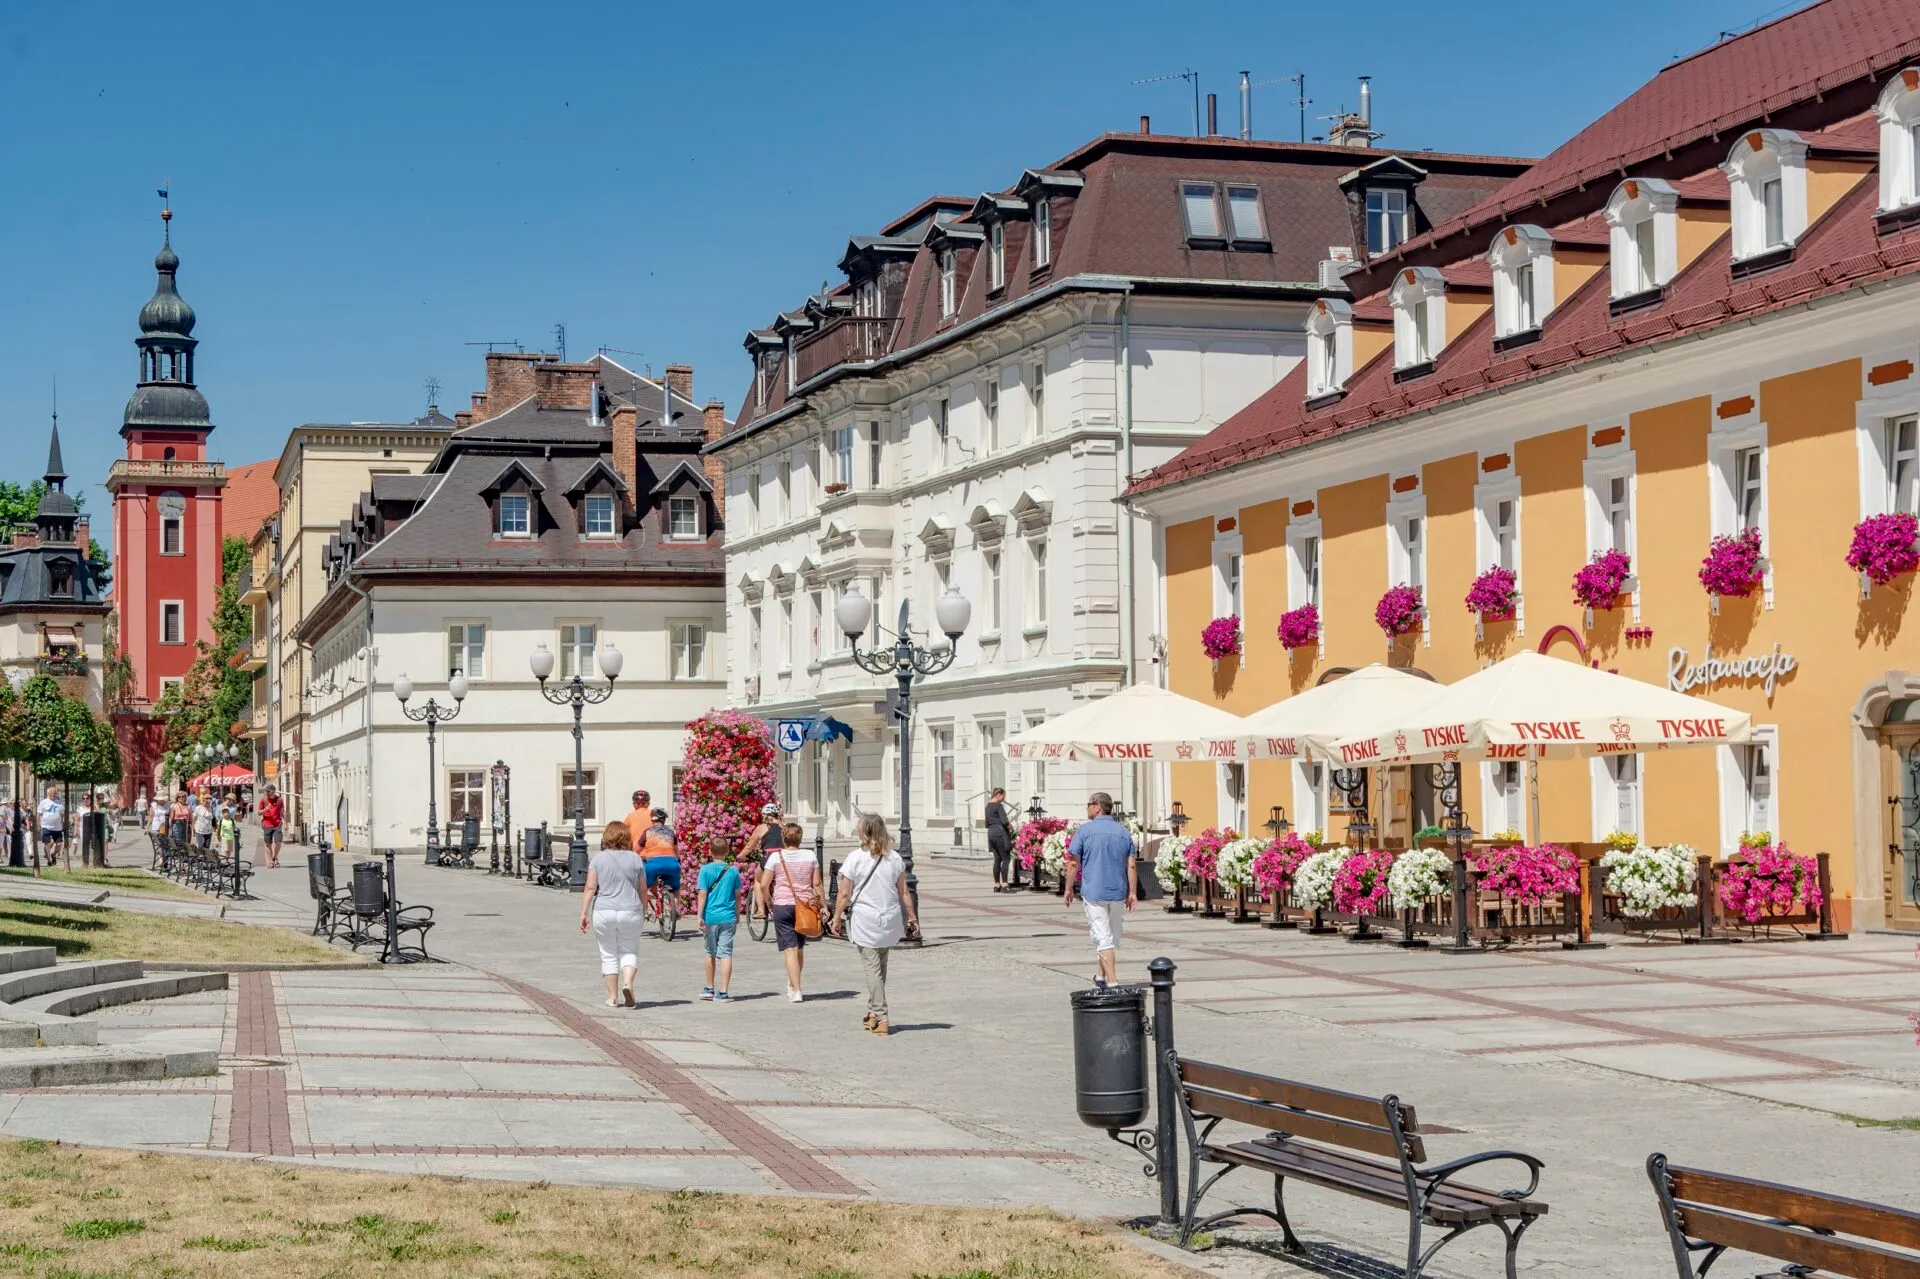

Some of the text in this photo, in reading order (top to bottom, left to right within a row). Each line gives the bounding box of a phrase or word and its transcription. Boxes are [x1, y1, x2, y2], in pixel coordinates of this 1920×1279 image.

[1667, 642, 1797, 698] Restauracja
[1511, 719, 1727, 740] TYSKIE TYSKIE
[1041, 743, 1064, 758] TYSKIE
[1094, 743, 1153, 758] TYSKIE
[1208, 738, 1299, 757] TYSKIE TYSKIE
[1340, 724, 1469, 763] TYSKIE TYSKIE
